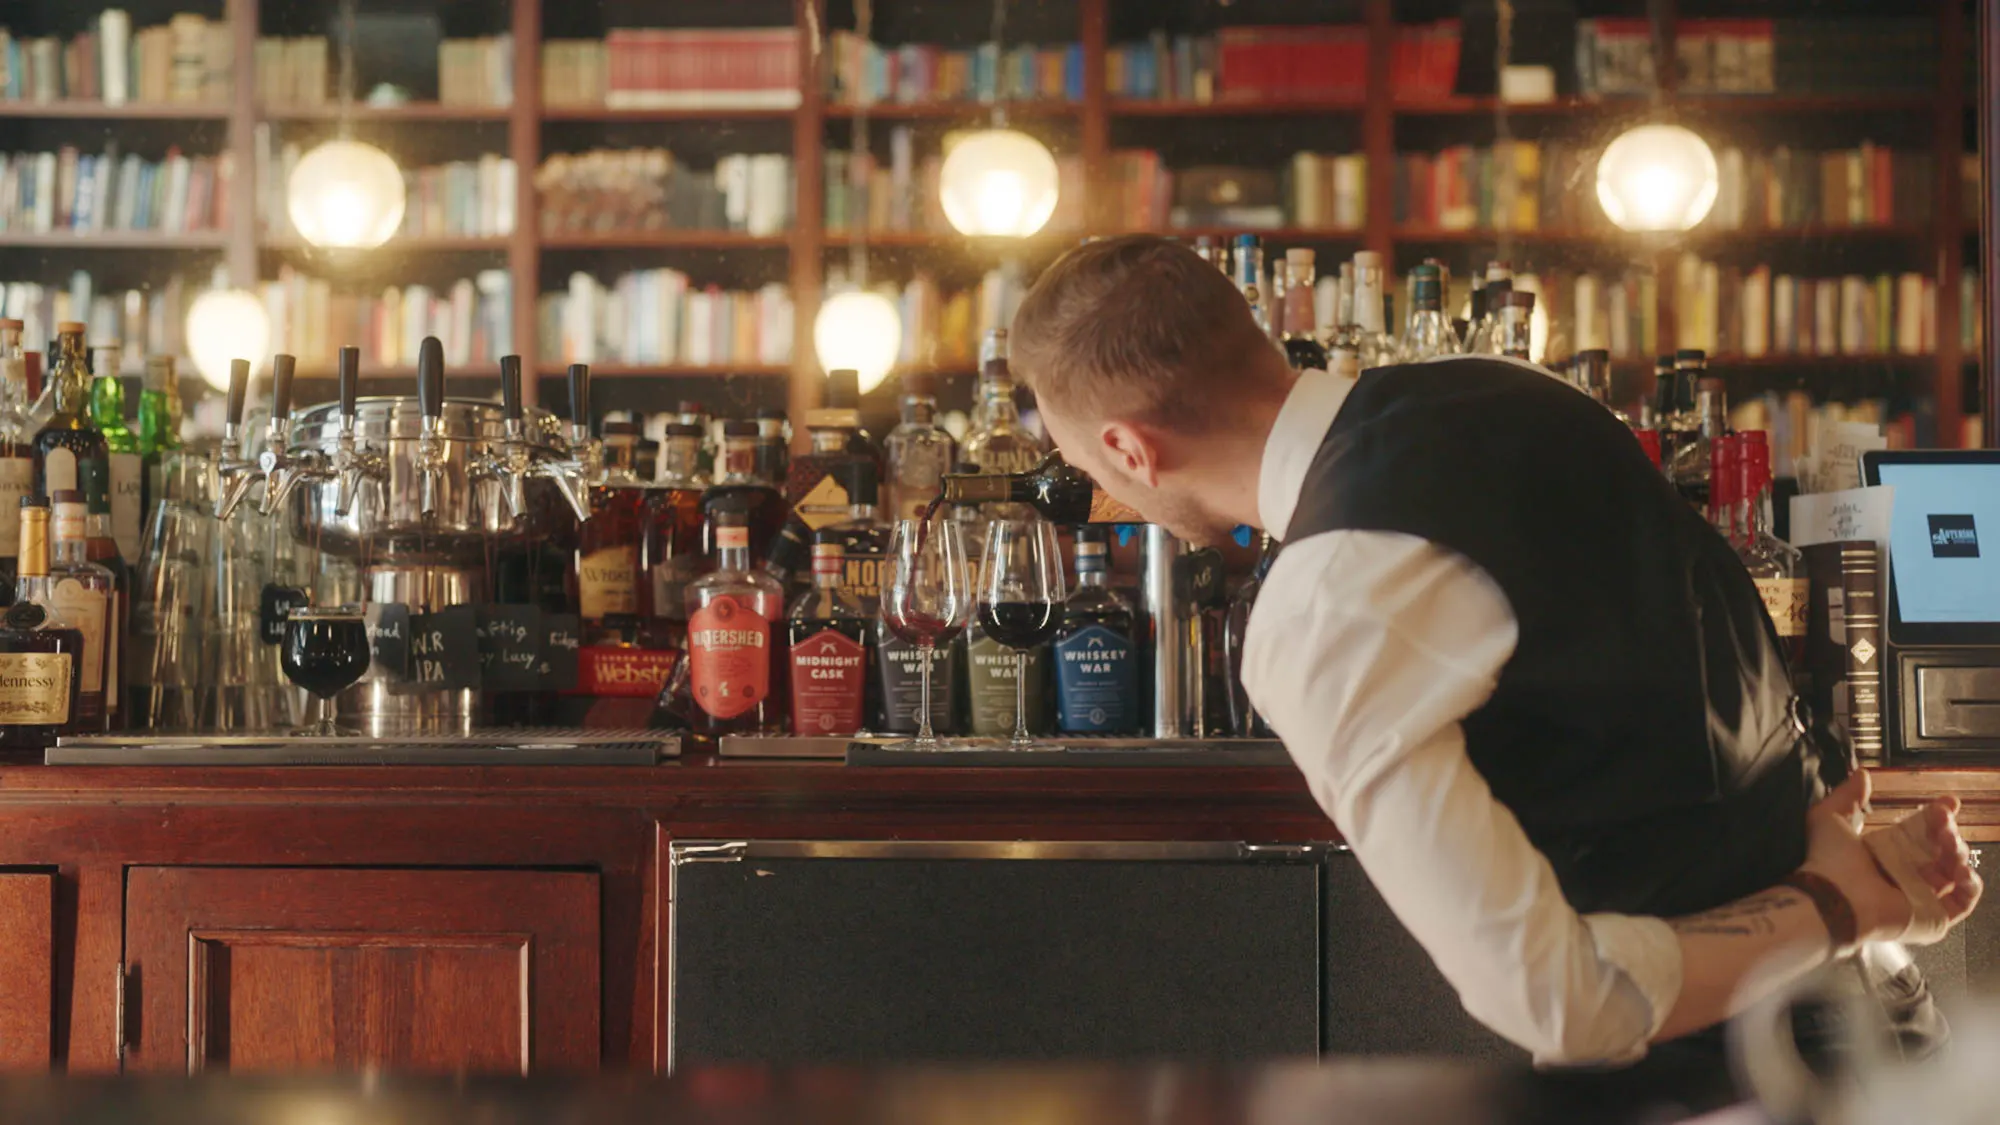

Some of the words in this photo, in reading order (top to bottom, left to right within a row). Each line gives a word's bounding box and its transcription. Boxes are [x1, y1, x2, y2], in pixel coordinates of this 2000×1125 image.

[1064, 650, 1127, 661] WHISKEY
[796, 656, 859, 667] MIDNIGHT
[415, 659, 445, 683] IPA
[1080, 663, 1112, 673] WAR
[810, 669, 845, 680] CASK
